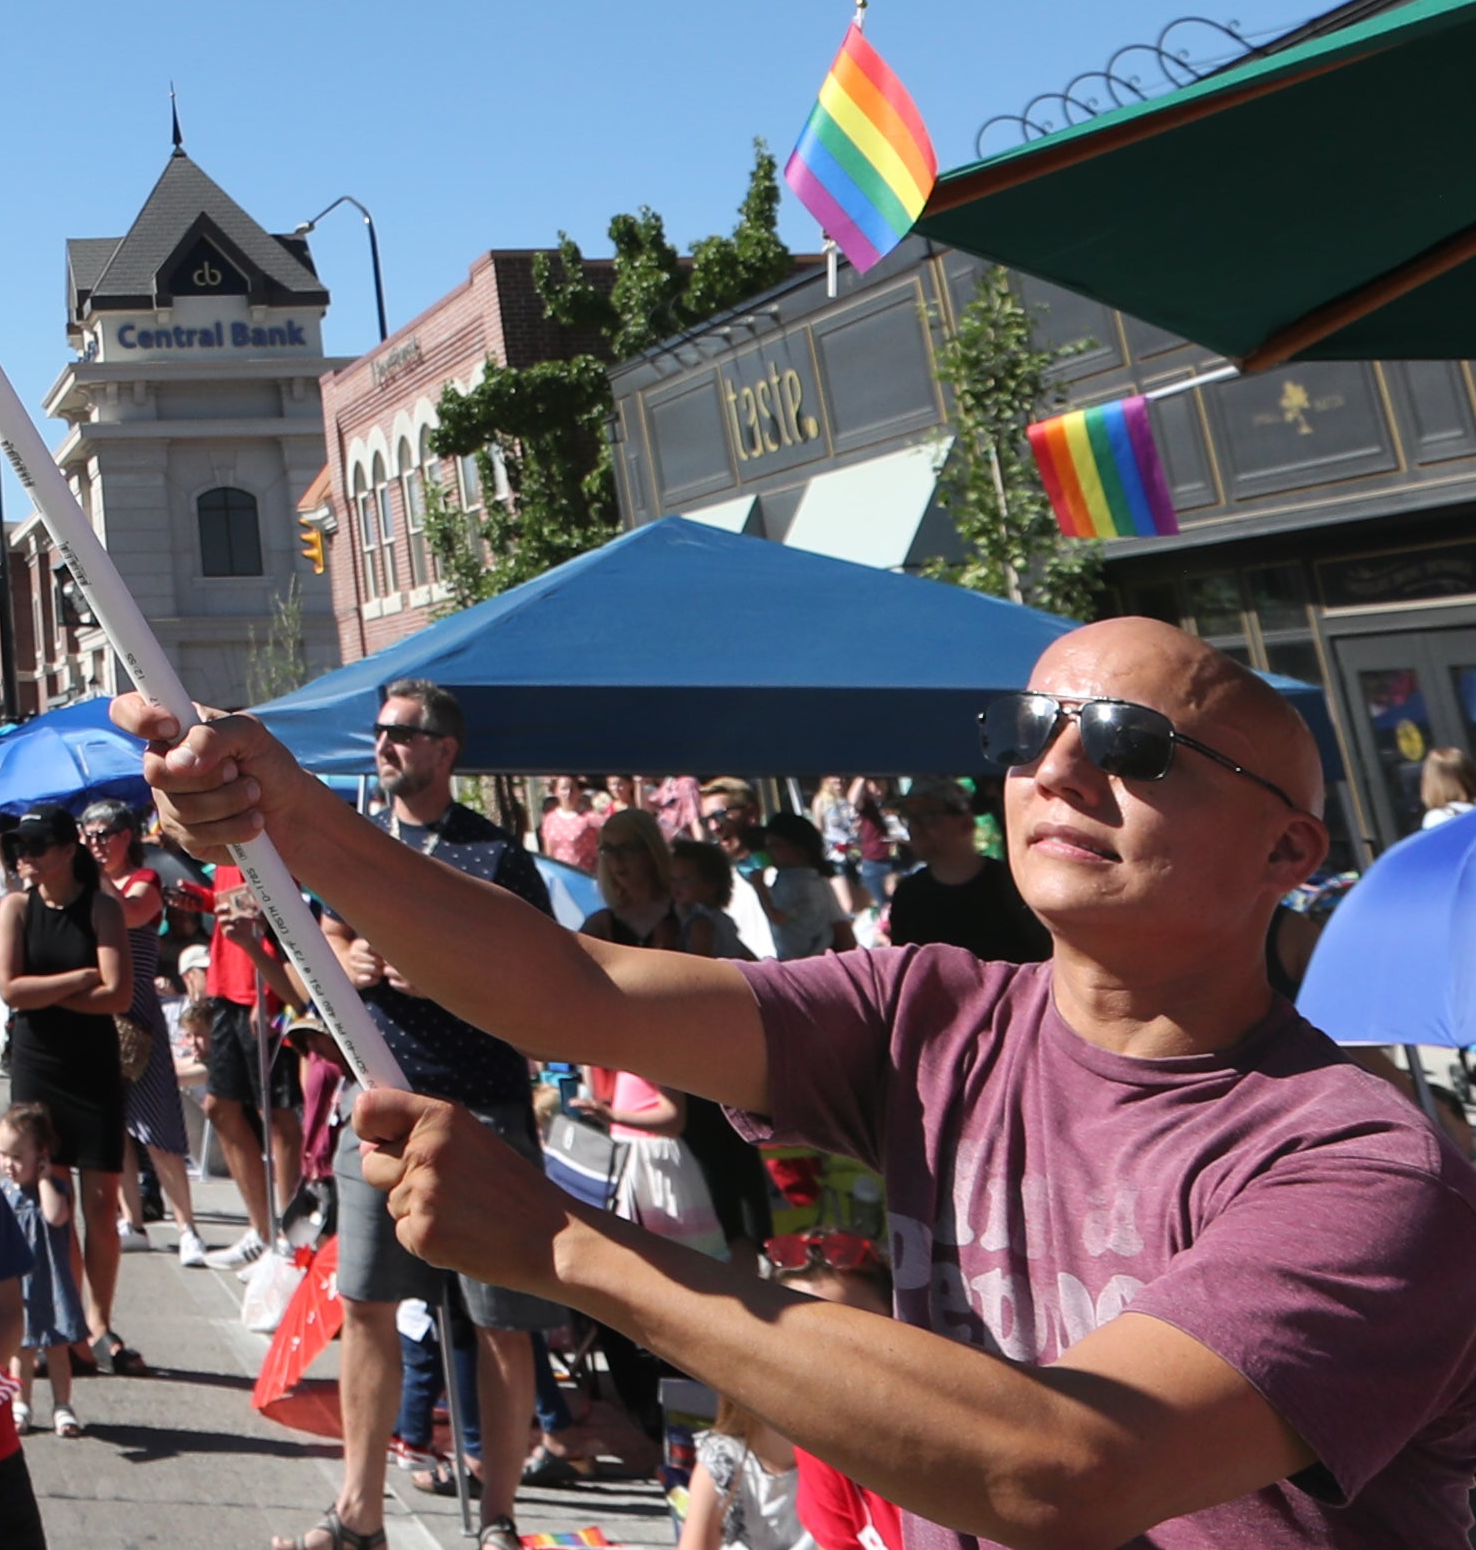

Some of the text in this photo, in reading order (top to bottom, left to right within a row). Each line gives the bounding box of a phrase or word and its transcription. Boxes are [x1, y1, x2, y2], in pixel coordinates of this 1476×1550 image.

[117, 319, 306, 349] Central Bank
[724, 361, 819, 461] taste.
[308, 977, 325, 998] PSI
[321, 998, 338, 1020] 480
[333, 1020, 347, 1037] PR
